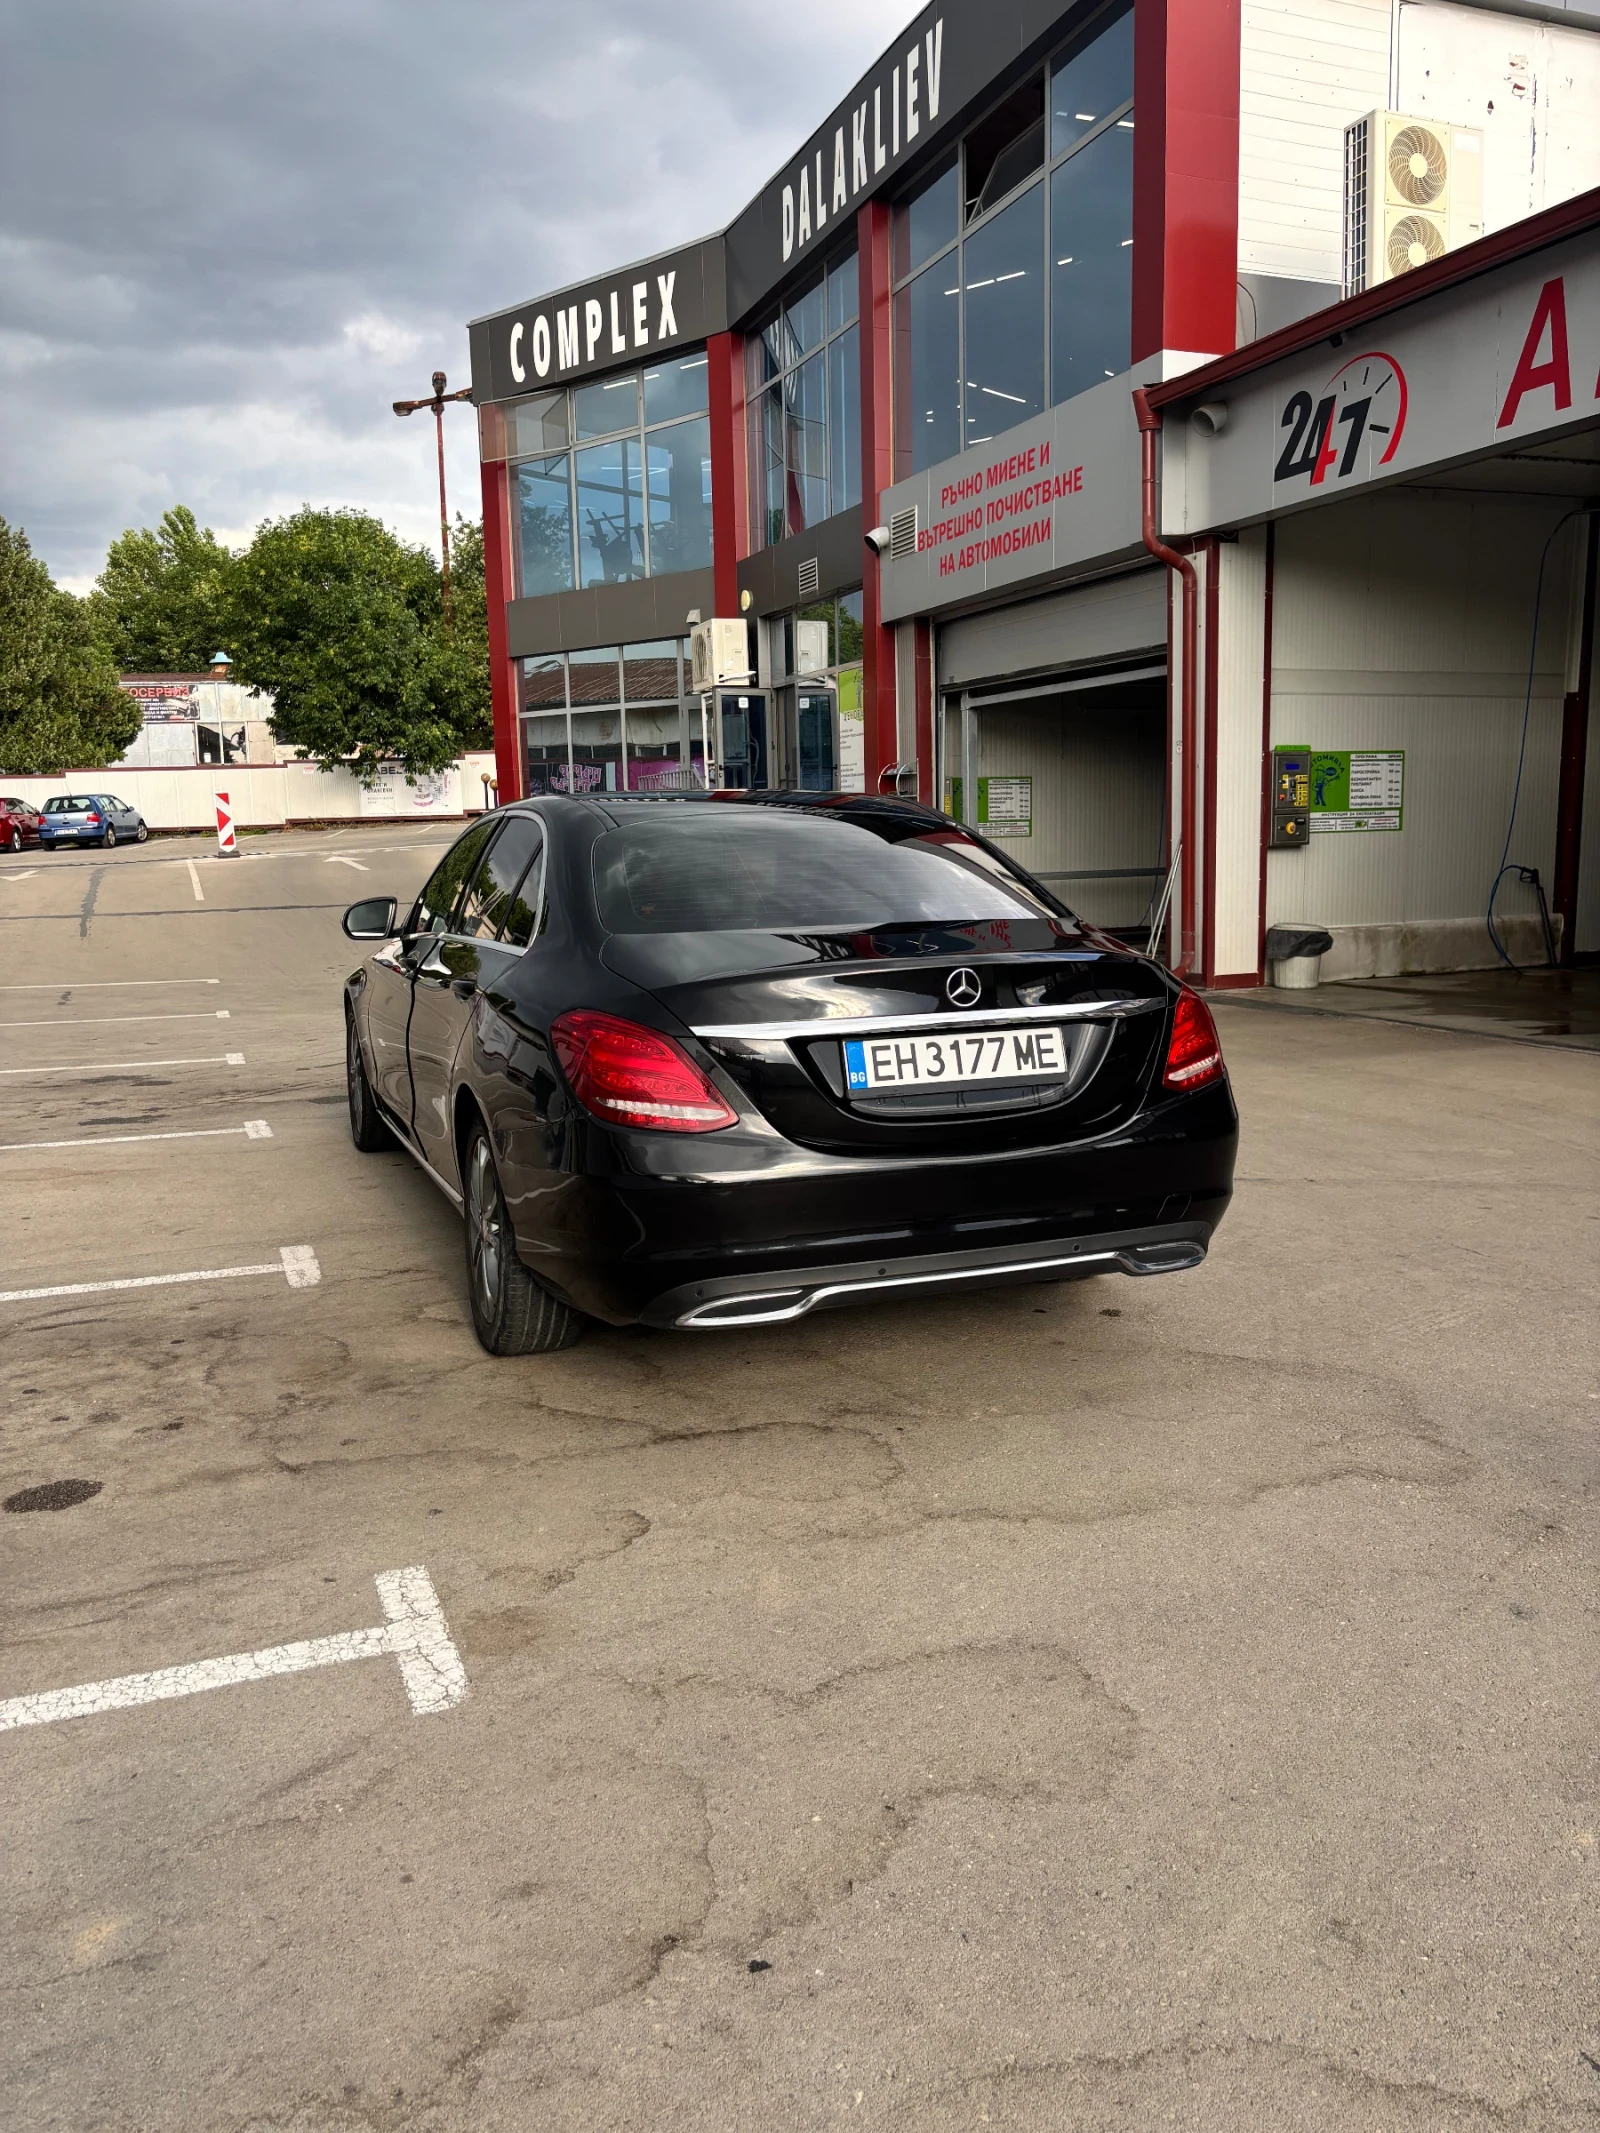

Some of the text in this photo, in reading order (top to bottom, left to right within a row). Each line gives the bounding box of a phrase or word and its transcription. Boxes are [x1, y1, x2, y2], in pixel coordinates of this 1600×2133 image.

[782, 18, 943, 262] DALAKLIEV
[509, 271, 678, 383] COMPLEX
[1496, 276, 1600, 430] А
[918, 466, 1083, 552] ВЪТРЕШНО ПОЧИСТВАНЕ
[941, 441, 1050, 509] РЪЧНО МИЕНЕ И
[940, 517, 1051, 577] НА АВТОМОБИЛИ
[851, 1072, 866, 1083] BG
[871, 1033, 1059, 1082] EH 3177 ME
